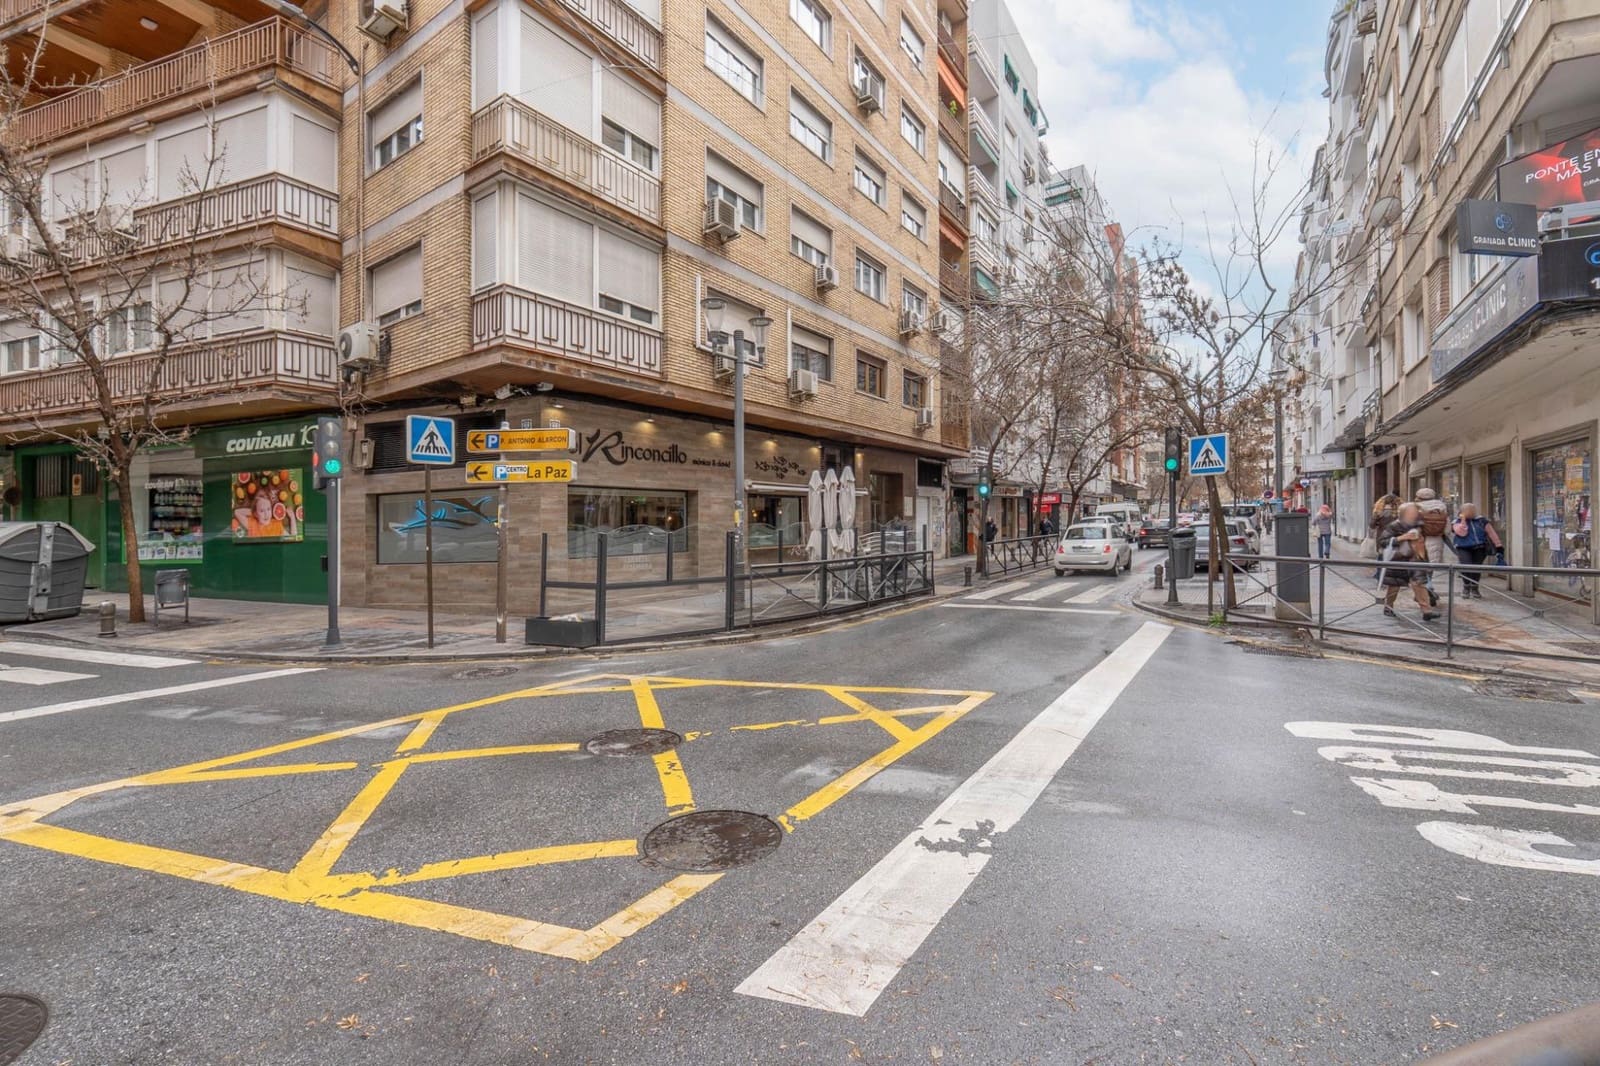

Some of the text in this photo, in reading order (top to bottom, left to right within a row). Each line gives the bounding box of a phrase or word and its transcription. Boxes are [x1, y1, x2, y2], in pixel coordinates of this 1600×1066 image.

[1525, 156, 1579, 184] PONTE
[1473, 236, 1536, 248] GRANADA CLINIC
[1475, 284, 1507, 329] CLINIC
[487, 435, 498, 448] P
[569, 429, 687, 466] l Rinconcillo
[527, 467, 541, 478] La
[545, 466, 567, 478] Paz
